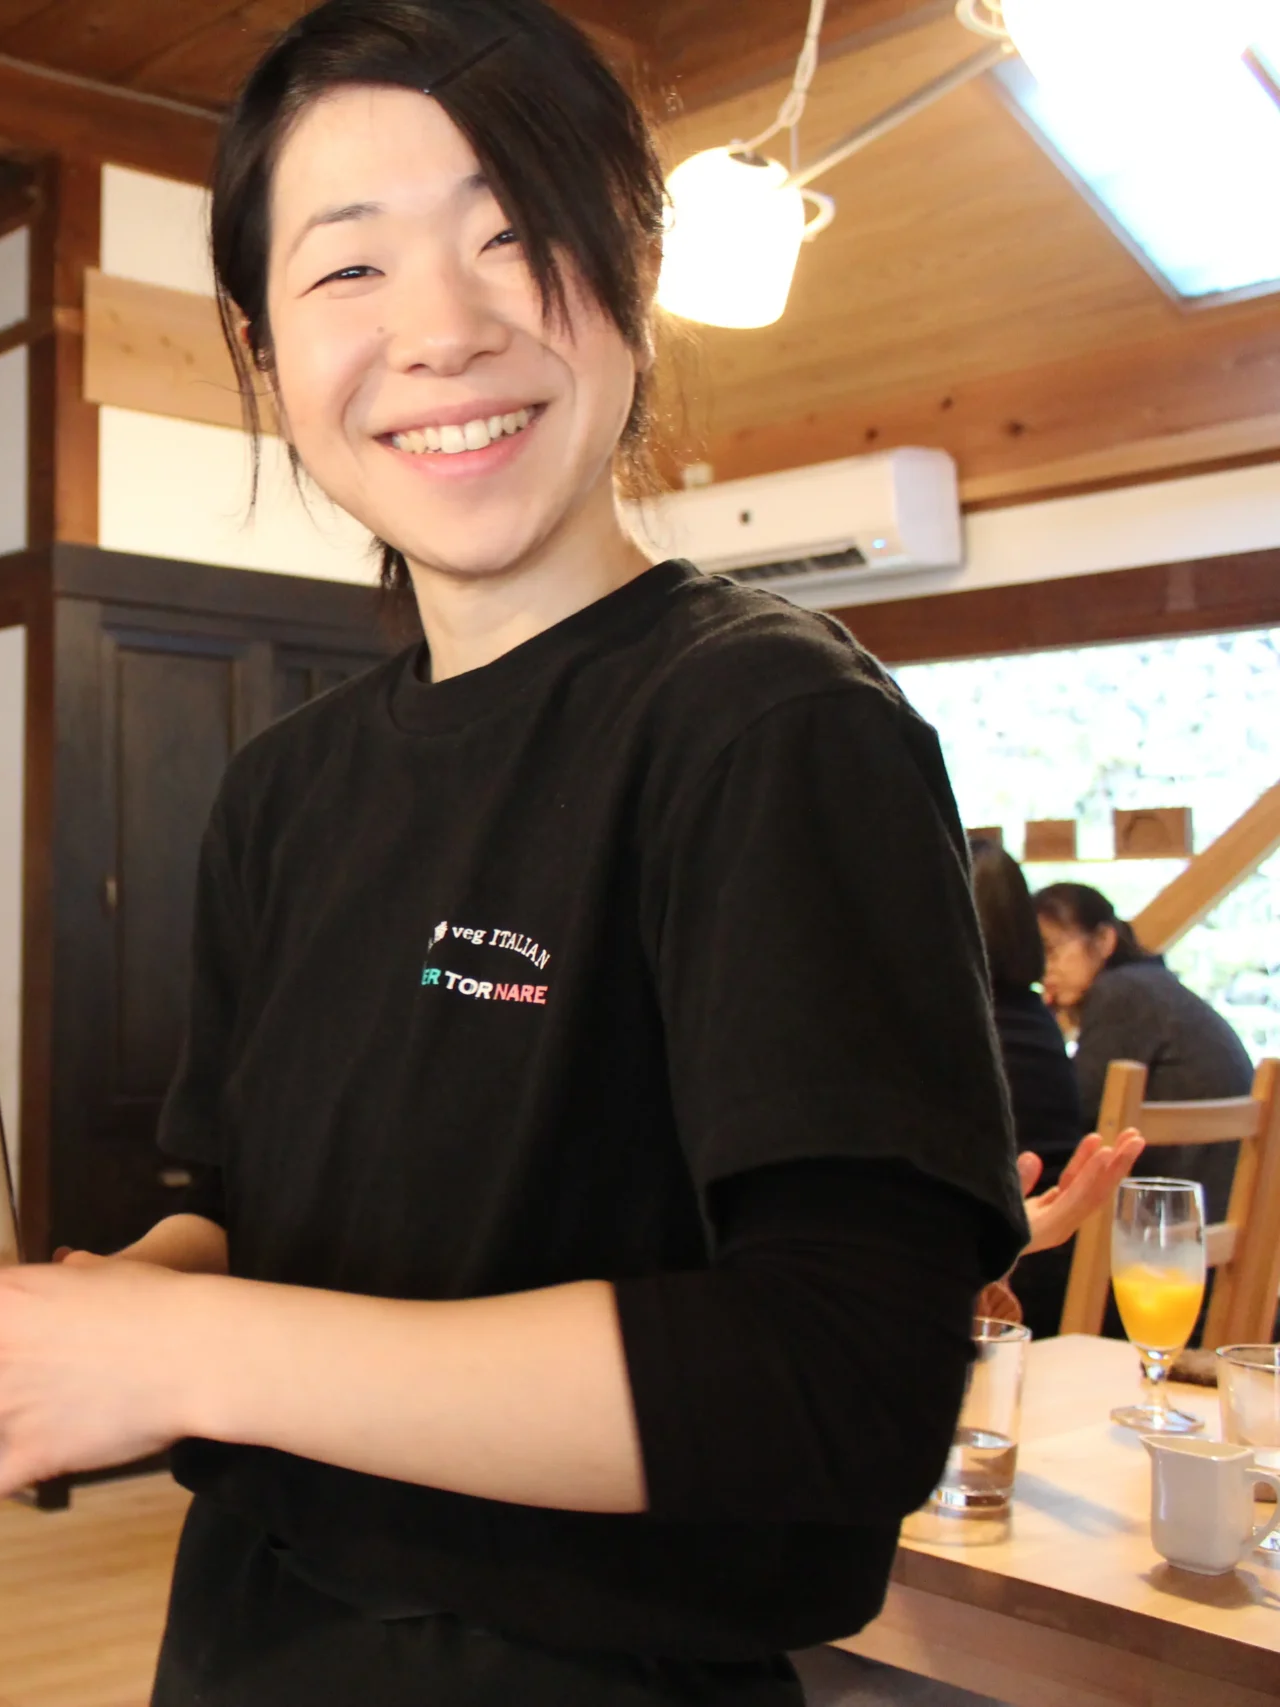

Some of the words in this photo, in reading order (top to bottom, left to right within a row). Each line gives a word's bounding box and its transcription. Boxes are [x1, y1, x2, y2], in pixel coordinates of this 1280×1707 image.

[451, 926, 486, 945] veg
[488, 928, 551, 970] ITALIAN
[444, 970, 548, 1004] TORNARE
